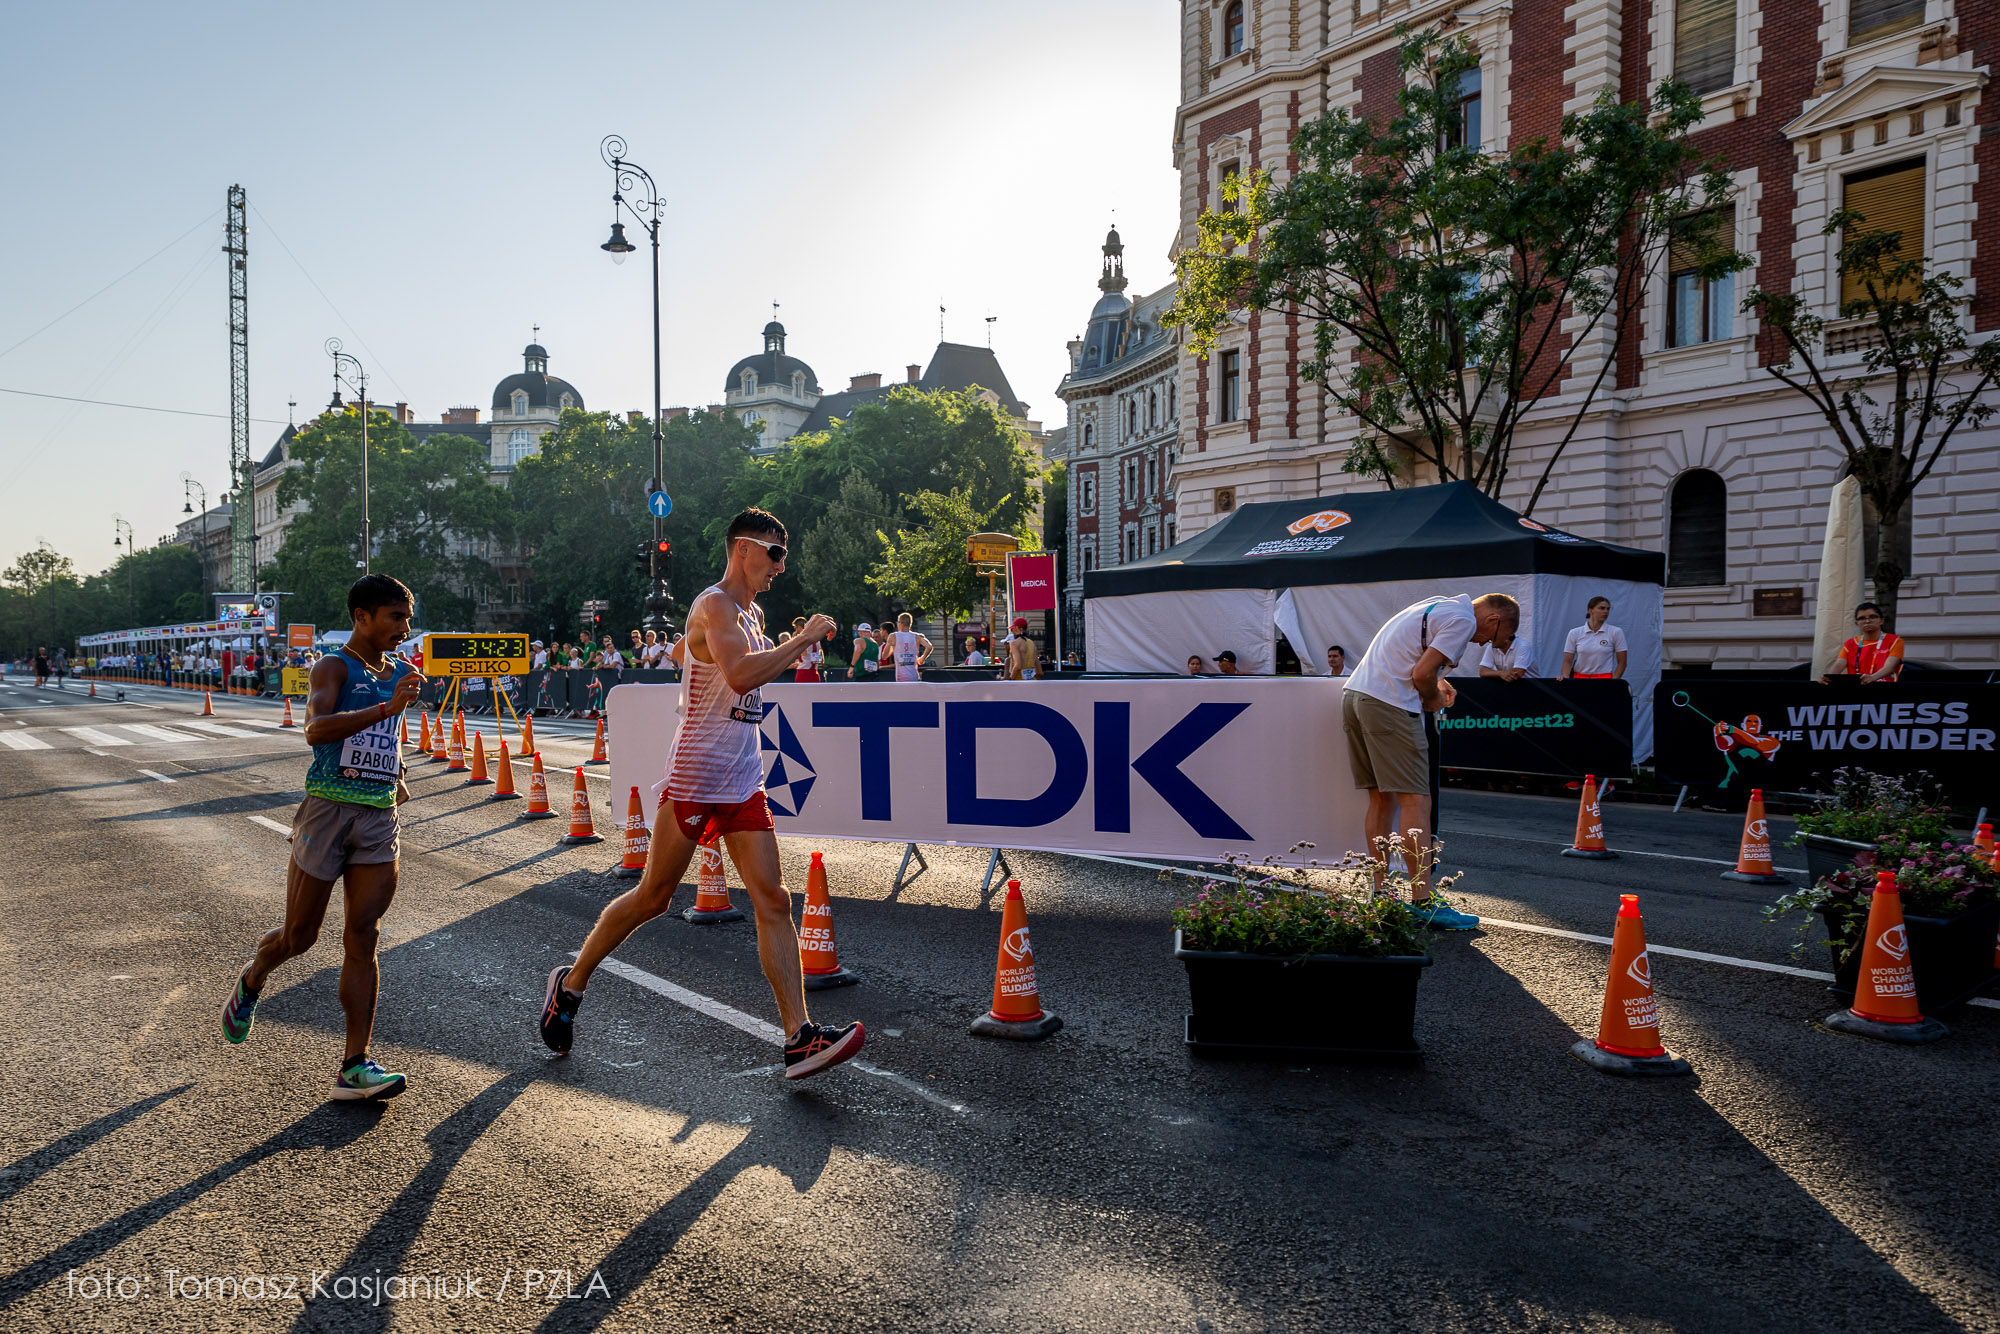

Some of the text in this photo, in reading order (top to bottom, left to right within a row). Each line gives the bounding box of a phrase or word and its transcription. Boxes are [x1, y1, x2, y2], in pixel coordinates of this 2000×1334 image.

[1020, 579, 1048, 588] MEDICAL
[449, 660, 511, 674] SEIKO
[1787, 702, 1969, 727] WITNESS
[365, 732, 398, 752] TDK
[1767, 728, 1997, 751] THE WONDER
[350, 749, 396, 772] BABOO
[812, 701, 1256, 841] TDK
[1000, 967, 1025, 977] WORLD
[1871, 967, 1906, 976] WORLD
[1622, 995, 1654, 1007] WORLD
